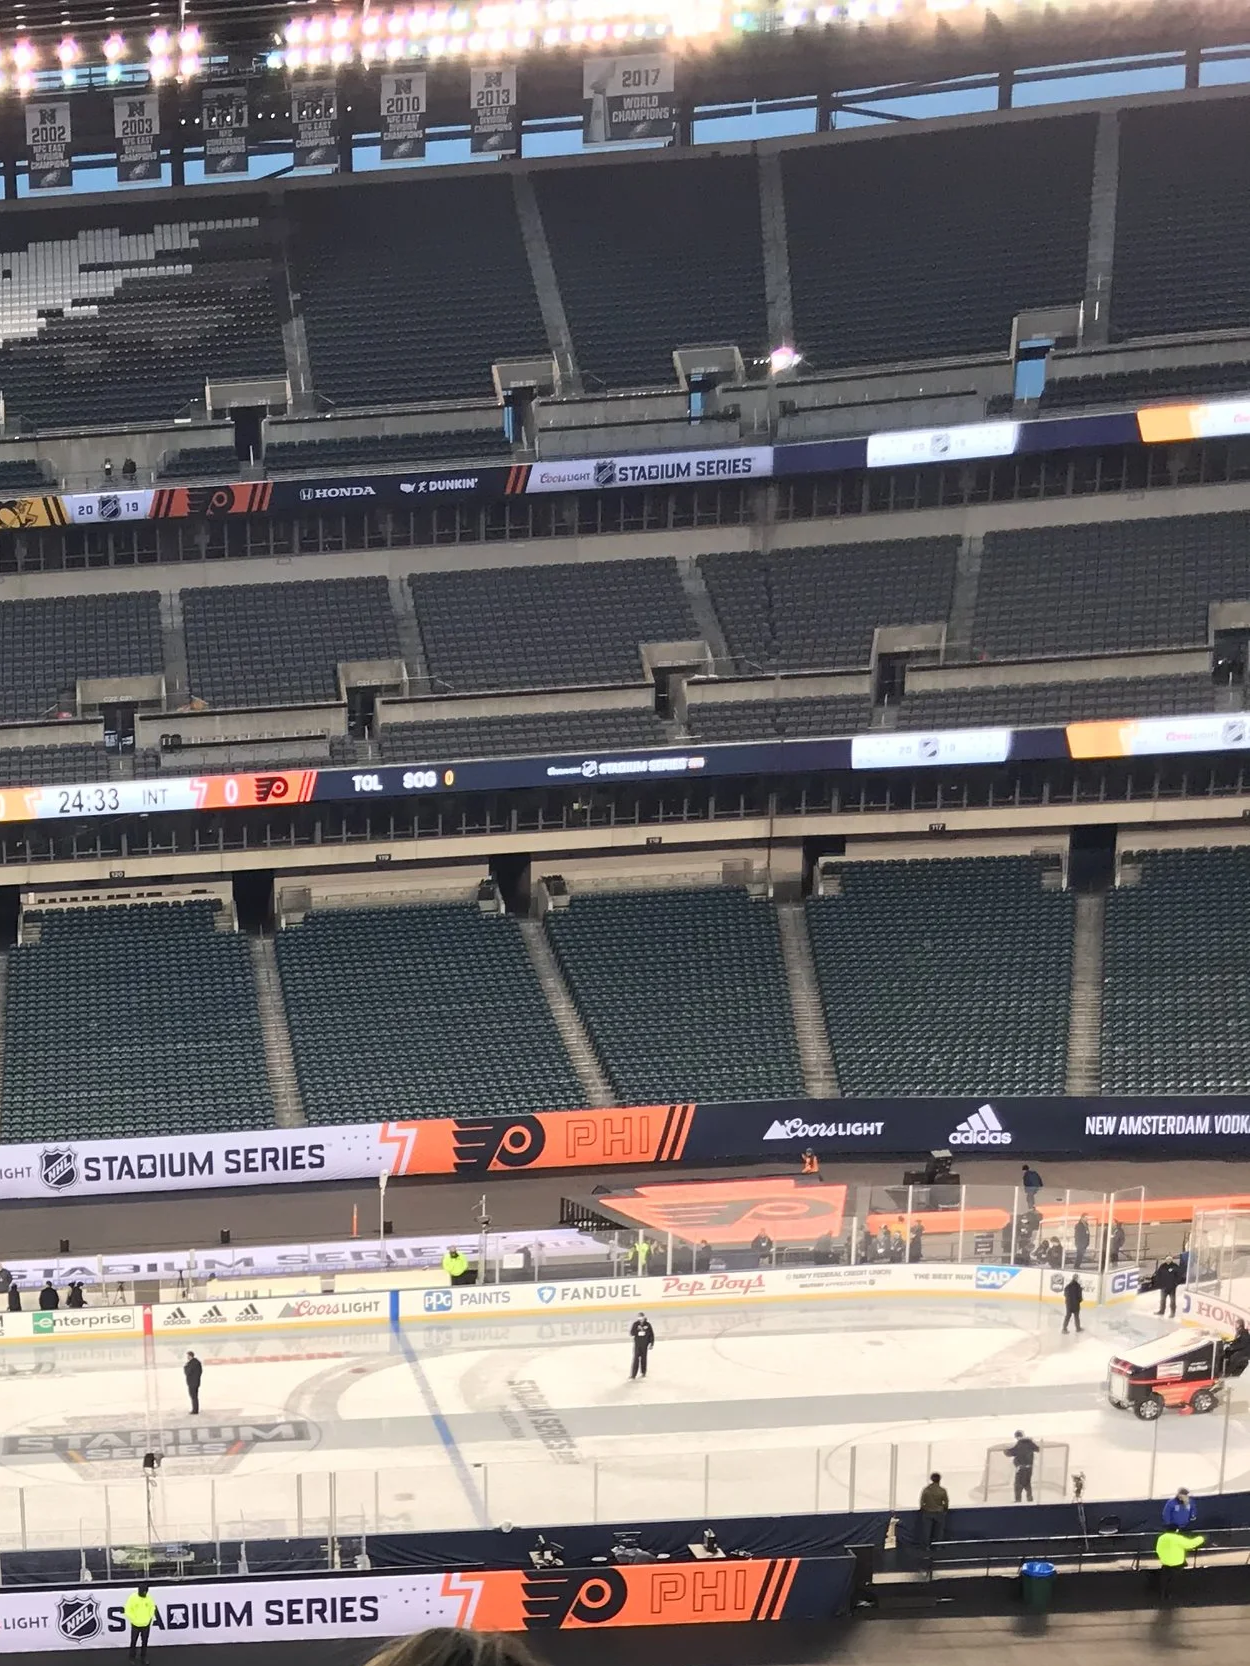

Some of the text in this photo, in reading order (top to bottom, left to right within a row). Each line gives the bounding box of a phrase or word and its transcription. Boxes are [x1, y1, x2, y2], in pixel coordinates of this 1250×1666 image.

[622, 68, 661, 88] 2017
[387, 96, 420, 113] 2010
[477, 89, 510, 106] 2013
[623, 95, 659, 109] WORLD
[612, 107, 670, 123] CHAMPIONS
[32, 126, 66, 143] 2002
[122, 119, 152, 136] 2003
[540, 458, 752, 484] Coors LIGHT STADIUM SERIES
[315, 486, 376, 498] HONDA
[429, 478, 478, 492] DUNKIN'
[78, 505, 93, 516] 20
[126, 502, 139, 512] 19
[599, 761, 647, 775] STADIUM
[648, 757, 688, 771] SERIES
[353, 772, 383, 792] TOL
[403, 770, 437, 789] SOG
[58, 789, 120, 814] 24:33
[143, 788, 168, 808] INT
[225, 779, 238, 805] 0
[785, 1117, 885, 1138] Coors LIGHT
[1085, 1115, 1208, 1136] NEW AMSTERDAM
[564, 1115, 651, 1160] PHI
[949, 1129, 1013, 1145] adidas
[47, 1154, 72, 1183] NHL
[84, 1143, 326, 1181] STADIUM SERIES
[9, 1255, 252, 1280] STADIUM
[662, 1273, 765, 1296] Pep Boys
[929, 1273, 953, 1281] BEST
[954, 1273, 973, 1281] RUN
[976, 1270, 1010, 1286] SAP
[424, 1291, 511, 1311] PPG PAINTS
[561, 1284, 642, 1301] FANDUEL
[293, 1300, 381, 1316] Coors LIGHT
[38, 1313, 132, 1330] enterprise
[163, 1318, 191, 1326] adidas
[199, 1316, 227, 1324] adidas
[235, 1314, 263, 1322] adidas
[17, 1421, 299, 1452] STADIUM
[85, 1441, 227, 1460] SERIES
[650, 1568, 748, 1616] PHI
[65, 1605, 95, 1634] NHL
[107, 1596, 379, 1633] SADIUM SERIES
[3, 1616, 49, 1632] LIGHT
